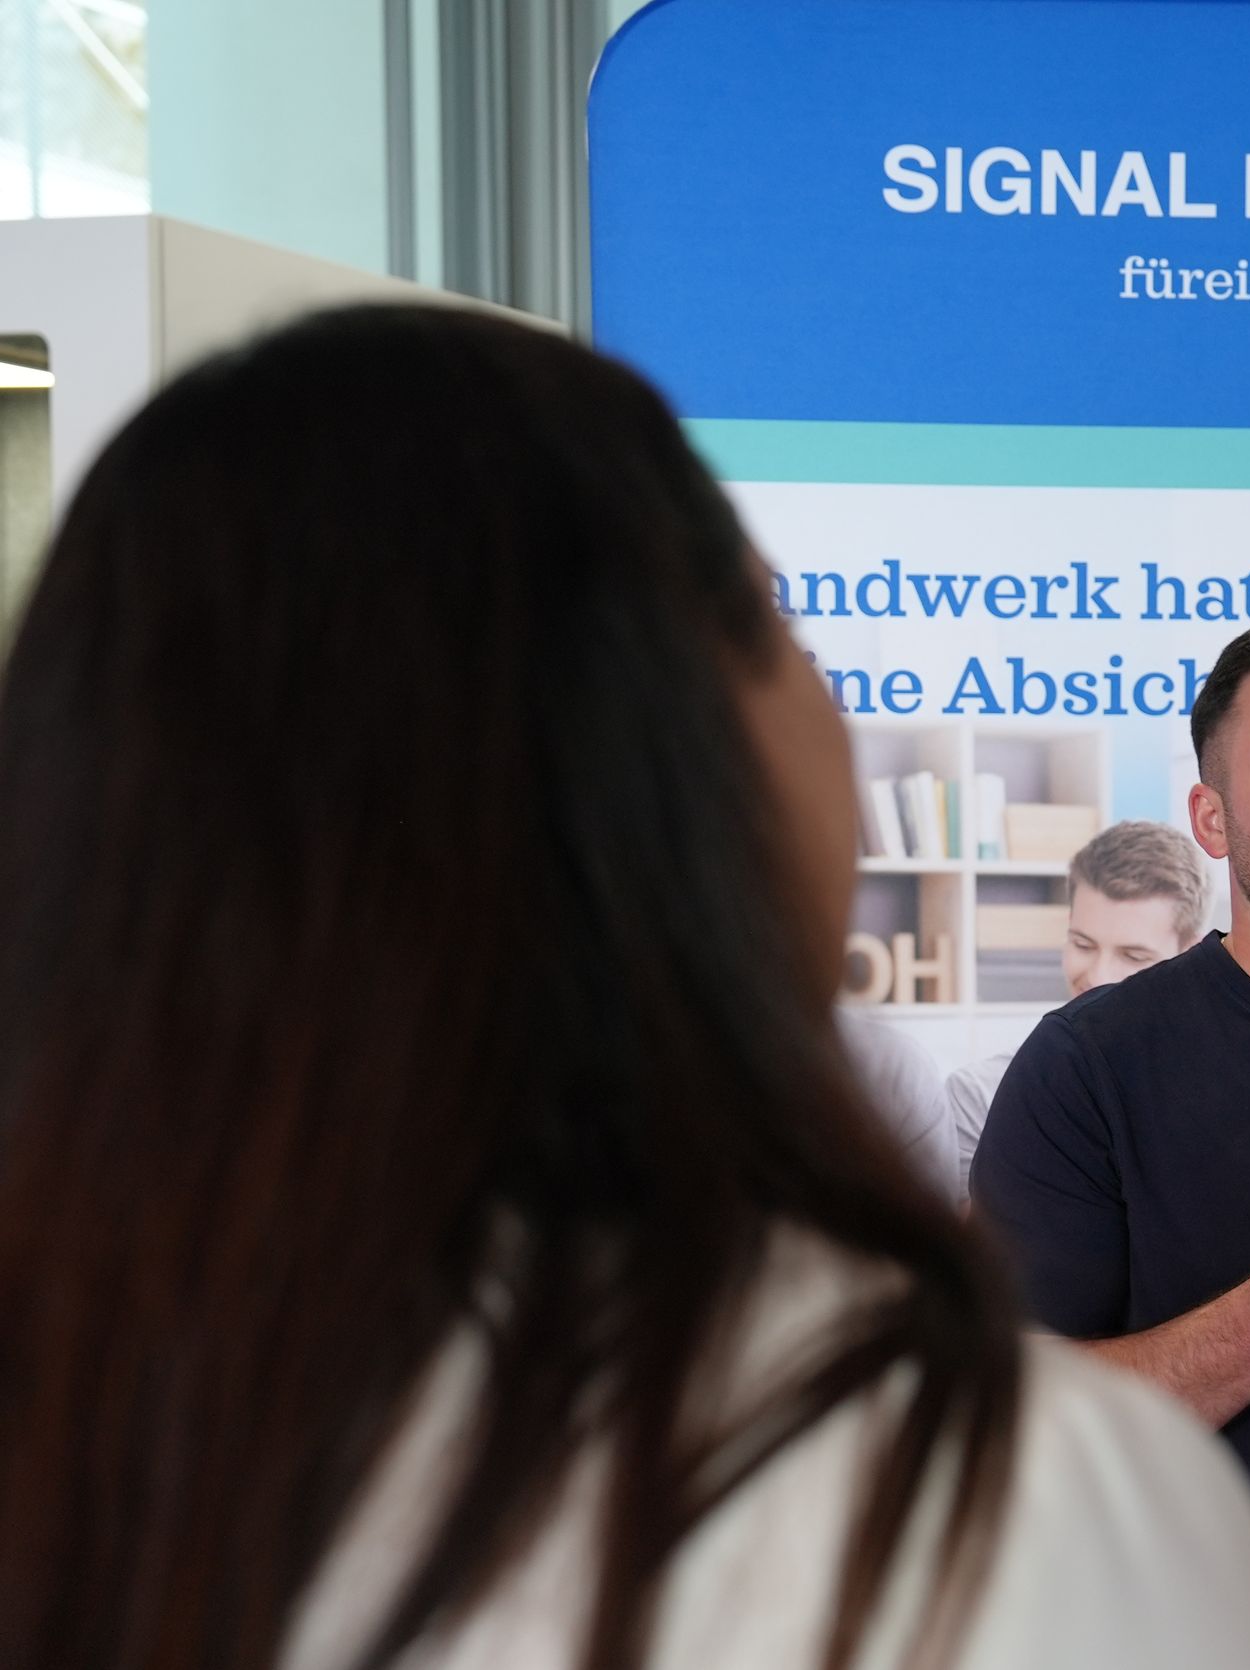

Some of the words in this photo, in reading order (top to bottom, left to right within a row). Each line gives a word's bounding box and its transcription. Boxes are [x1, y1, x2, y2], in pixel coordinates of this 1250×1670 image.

[882, 144, 1218, 218] SIGNAL
[768, 559, 1121, 619] andwerk
[804, 651, 923, 714] ne
